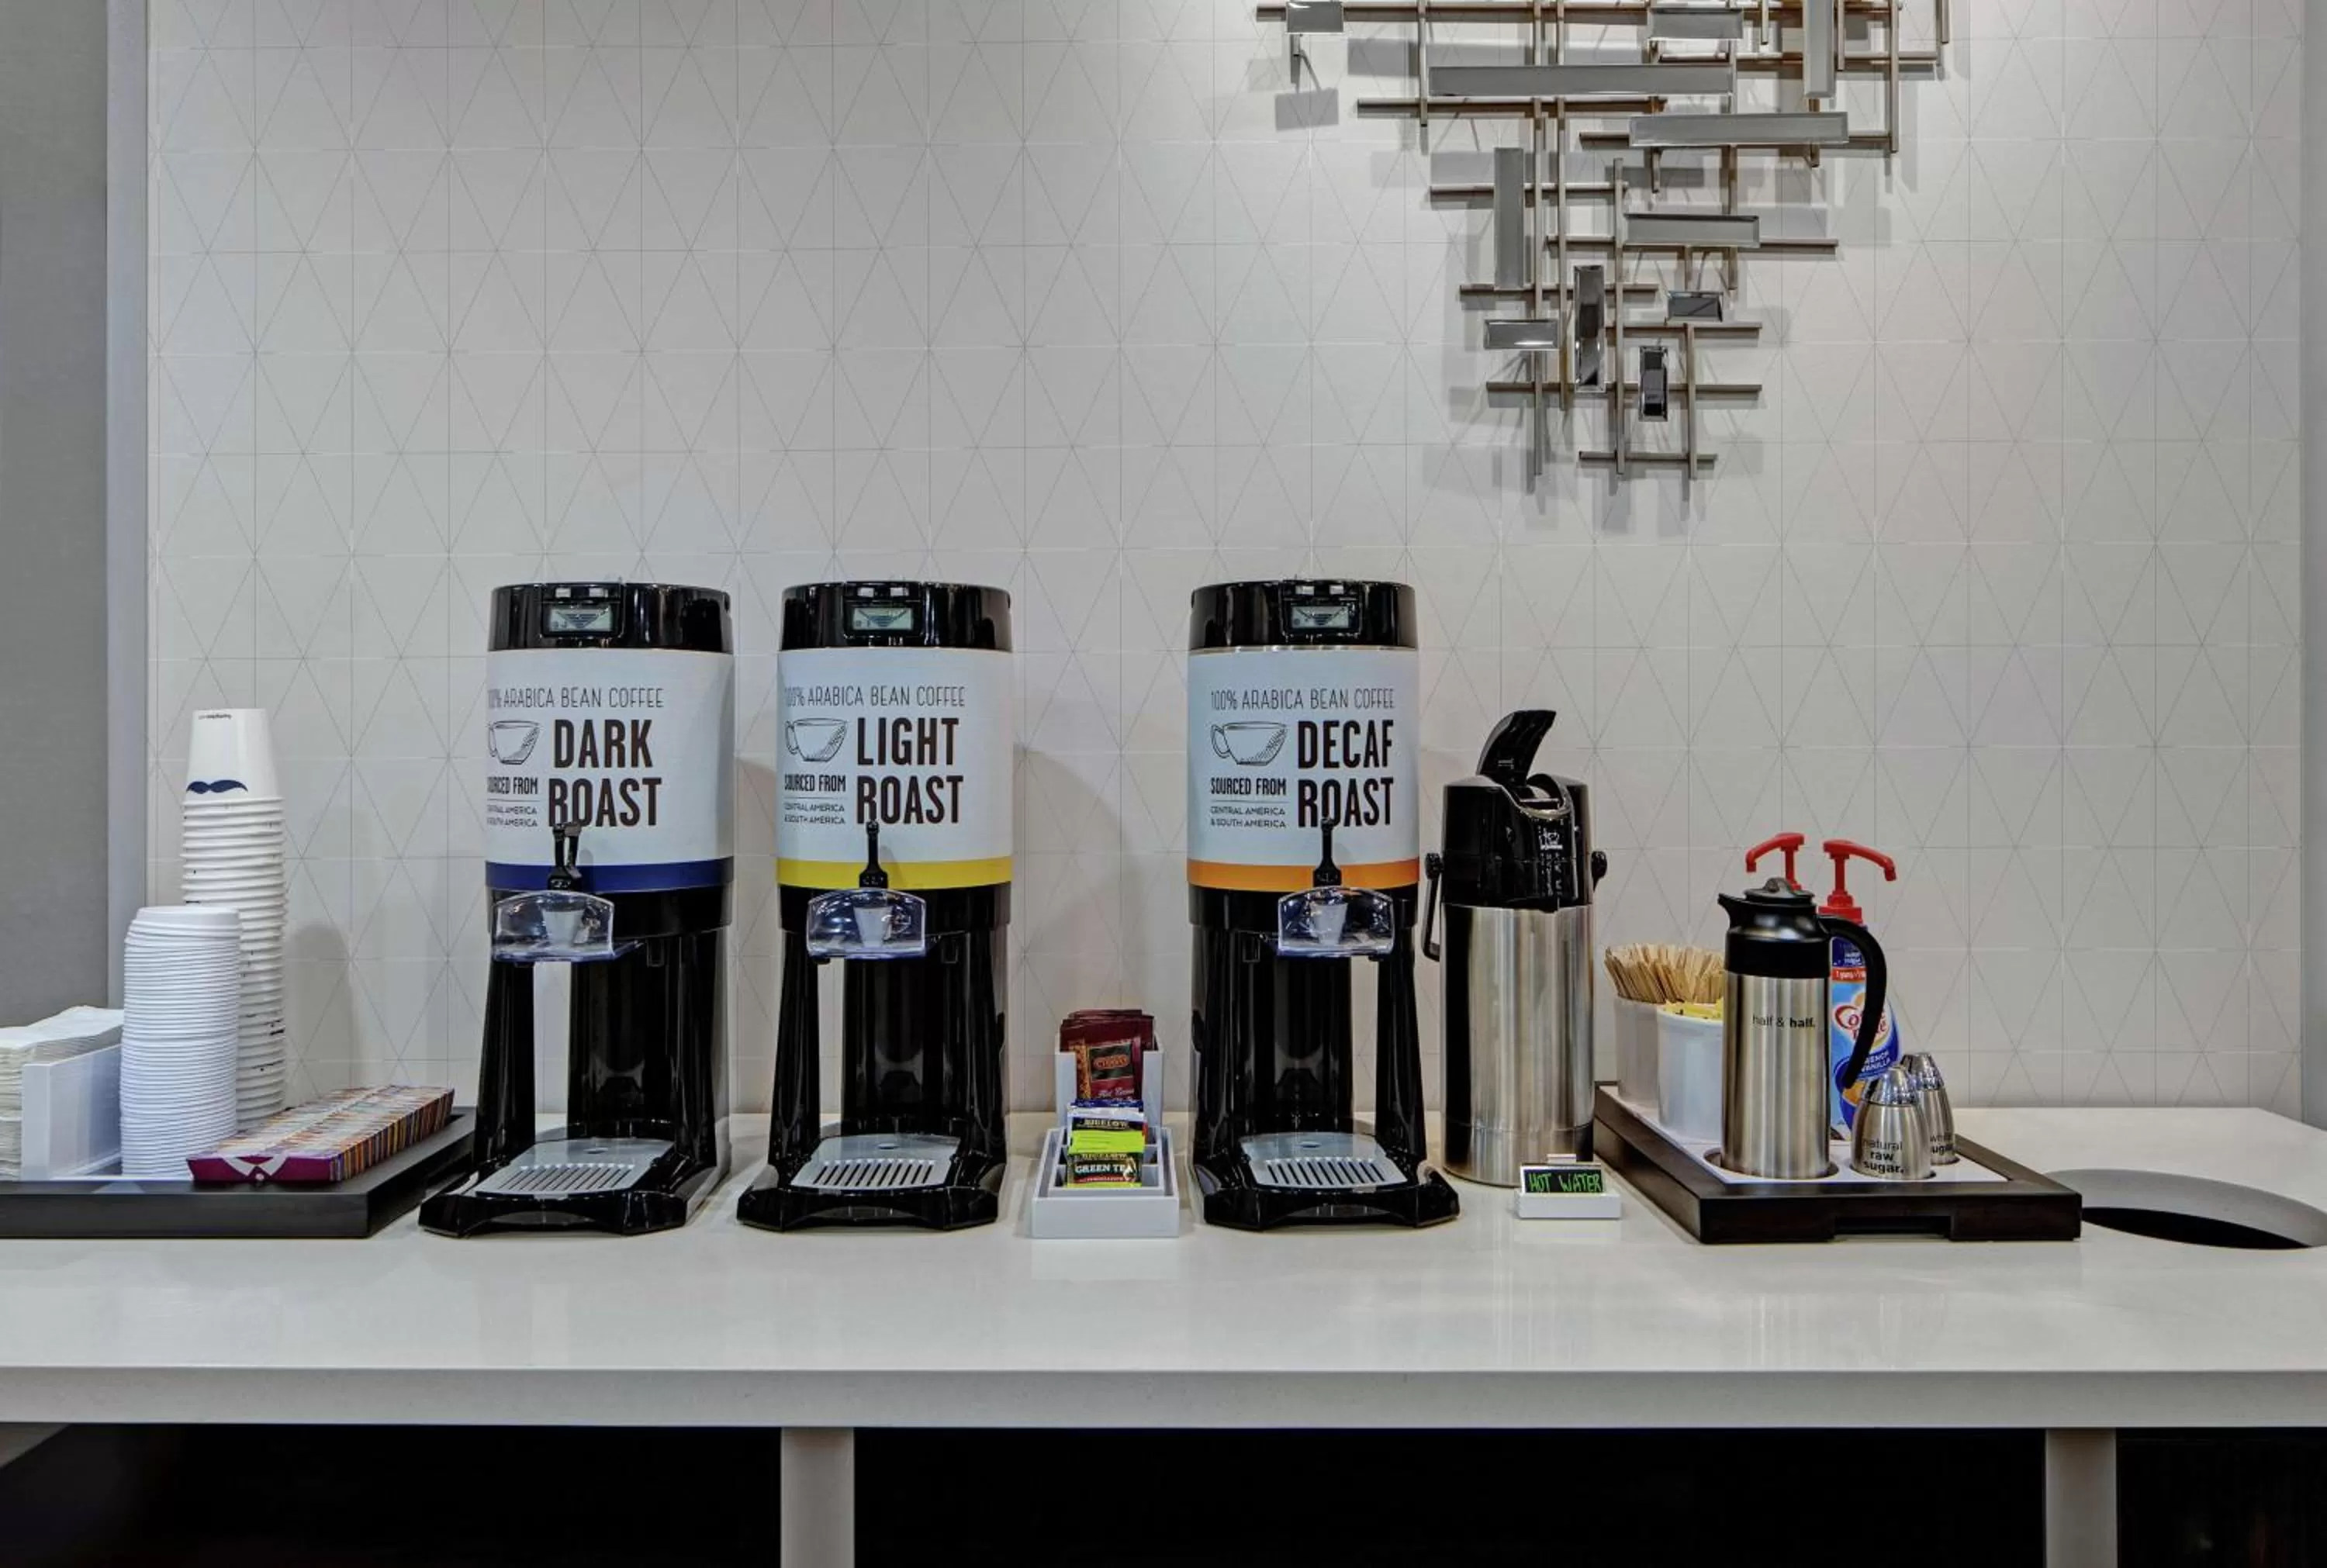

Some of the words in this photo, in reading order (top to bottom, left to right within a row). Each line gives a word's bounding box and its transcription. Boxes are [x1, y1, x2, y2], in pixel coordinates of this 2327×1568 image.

[503, 687, 555, 709] ARABICA
[560, 686, 601, 708] BEAN
[609, 687, 665, 708] COFFEE
[807, 686, 865, 706] ARABICA
[870, 686, 911, 706] BEAN
[916, 686, 966, 707] COFFEE
[1211, 689, 1237, 710] 100%
[1241, 688, 1304, 710] ARABICA
[1310, 687, 1349, 709] BEAN
[1354, 688, 1395, 709] COFFEE
[553, 719, 653, 768] DARK
[856, 717, 959, 766] LIGHT
[1298, 720, 1394, 769] DECAF
[513, 776, 538, 795] FROM
[818, 774, 846, 792] FROM
[1211, 778, 1251, 795] SOURCED
[1256, 778, 1287, 796] FROM
[548, 778, 662, 827] ROAST
[856, 775, 964, 824] ROAST
[1298, 777, 1395, 828] ROAST
[1776, 1017, 1785, 1027] &
[1870, 1151, 1895, 1161] raw
[1074, 1164, 1111, 1174] GREEN
[1529, 1173, 1552, 1193] HOT
[1558, 1173, 1603, 1193] WATER
